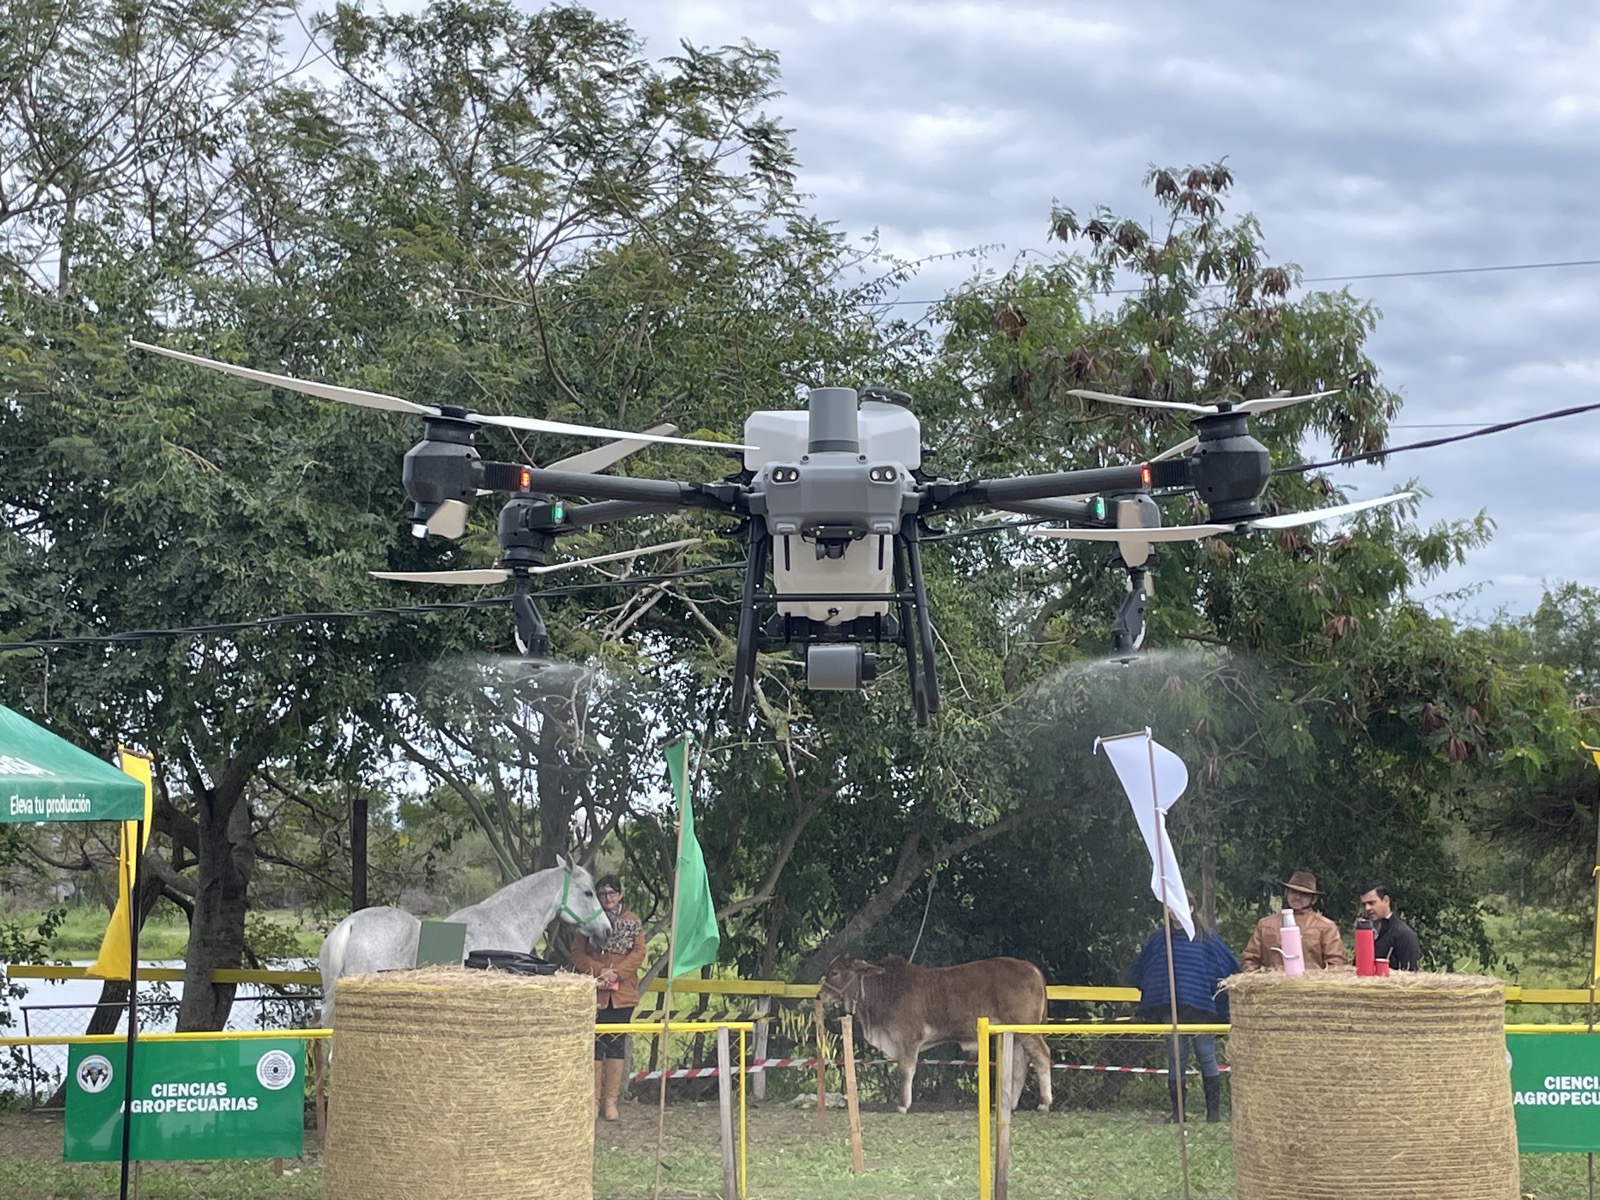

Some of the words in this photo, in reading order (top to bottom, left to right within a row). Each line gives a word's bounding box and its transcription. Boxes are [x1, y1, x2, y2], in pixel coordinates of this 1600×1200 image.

[10, 794, 33, 815] Eleva
[34, 796, 44, 814] tu
[46, 793, 91, 818] producción
[151, 1082, 227, 1098] CIENCIAS
[1544, 1076, 1600, 1090] CIENCI
